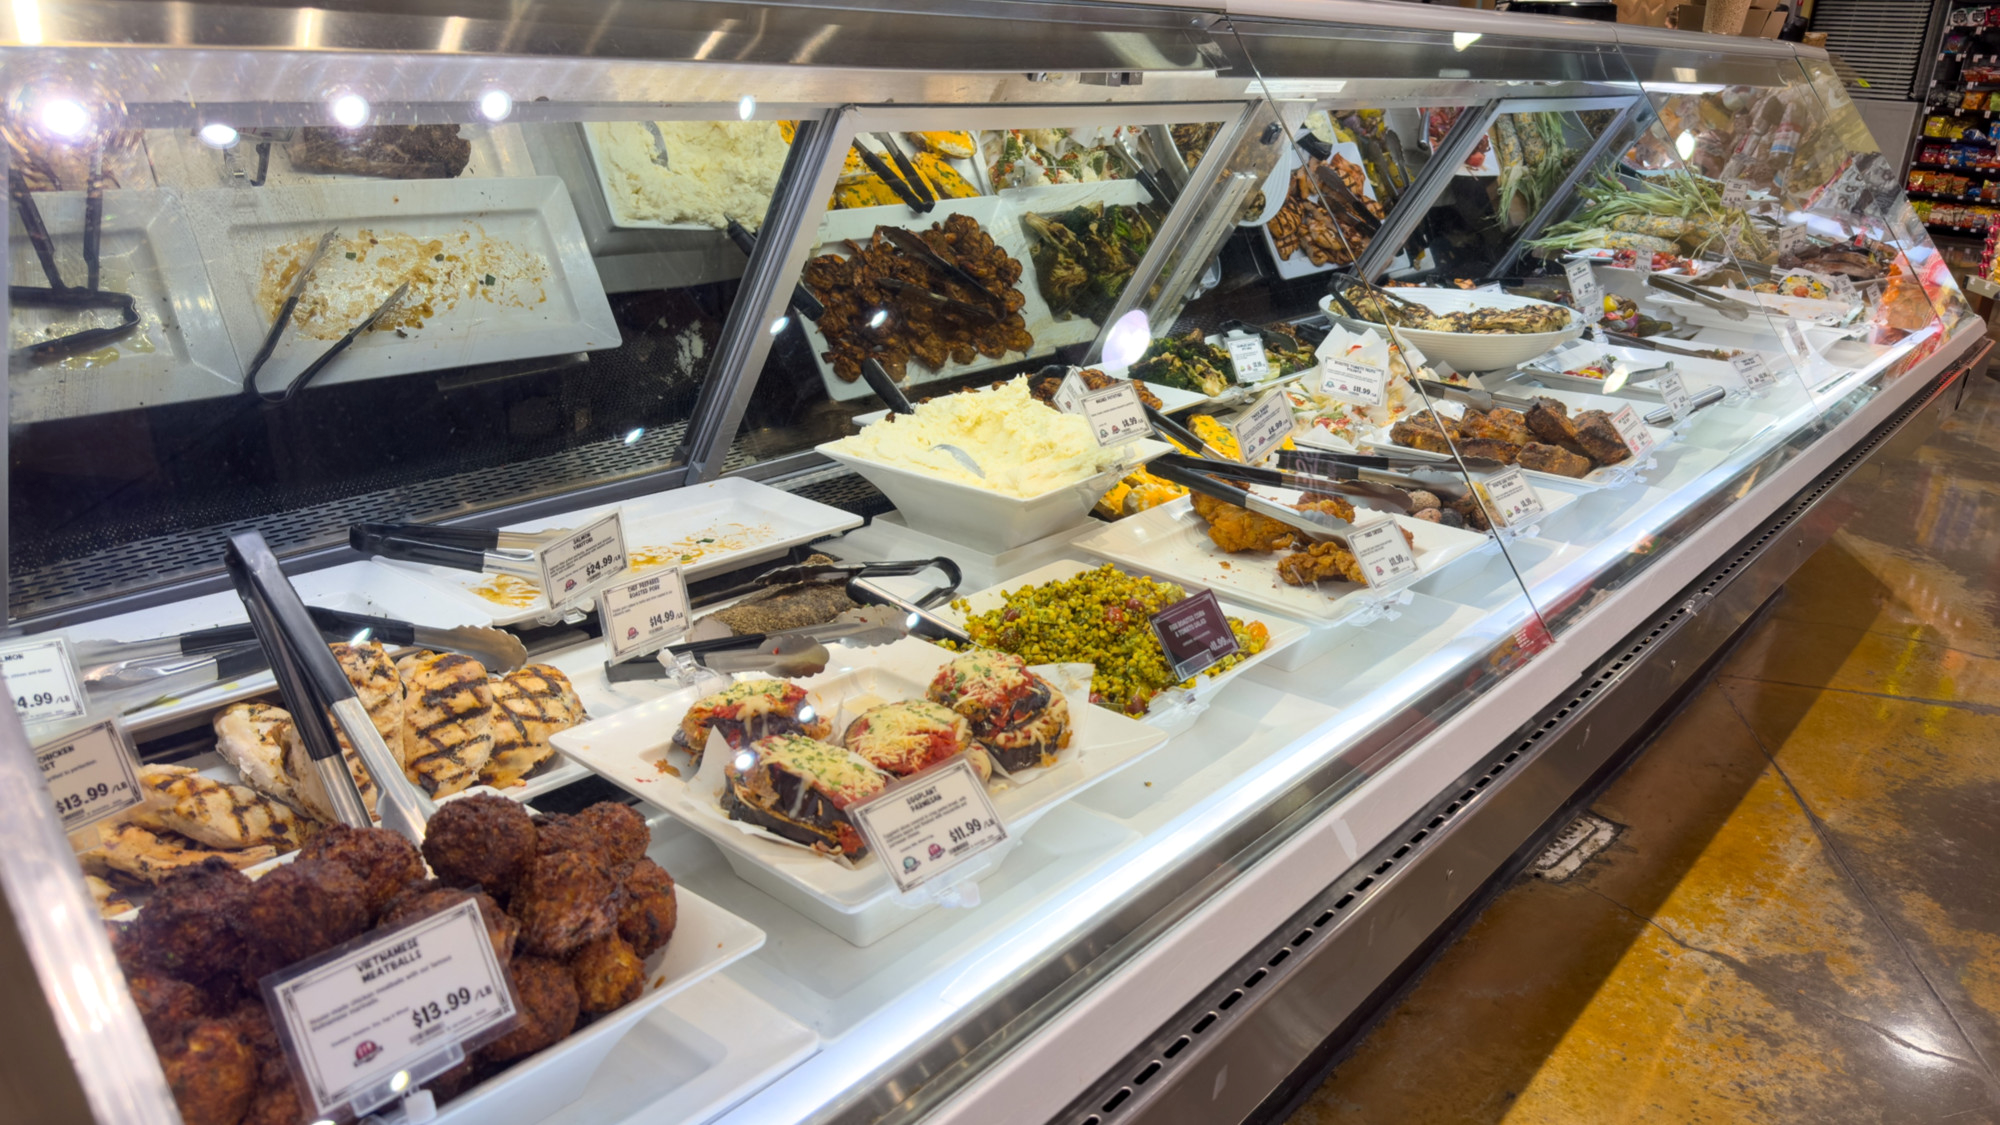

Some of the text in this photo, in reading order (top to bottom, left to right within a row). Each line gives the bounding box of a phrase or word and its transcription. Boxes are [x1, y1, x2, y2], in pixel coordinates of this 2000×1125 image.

[586, 554, 612, 576] $24.99
[650, 610, 674, 627] $14.99
[56, 783, 108, 814] $13.99
[906, 786, 935, 804] EGGPLANT
[910, 795, 942, 811] PARMESAN
[949, 818, 982, 843] $11.99
[358, 938, 417, 972] VIETNAMESE
[362, 951, 421, 982] MEATBALLS
[412, 987, 470, 1028] $13.99
